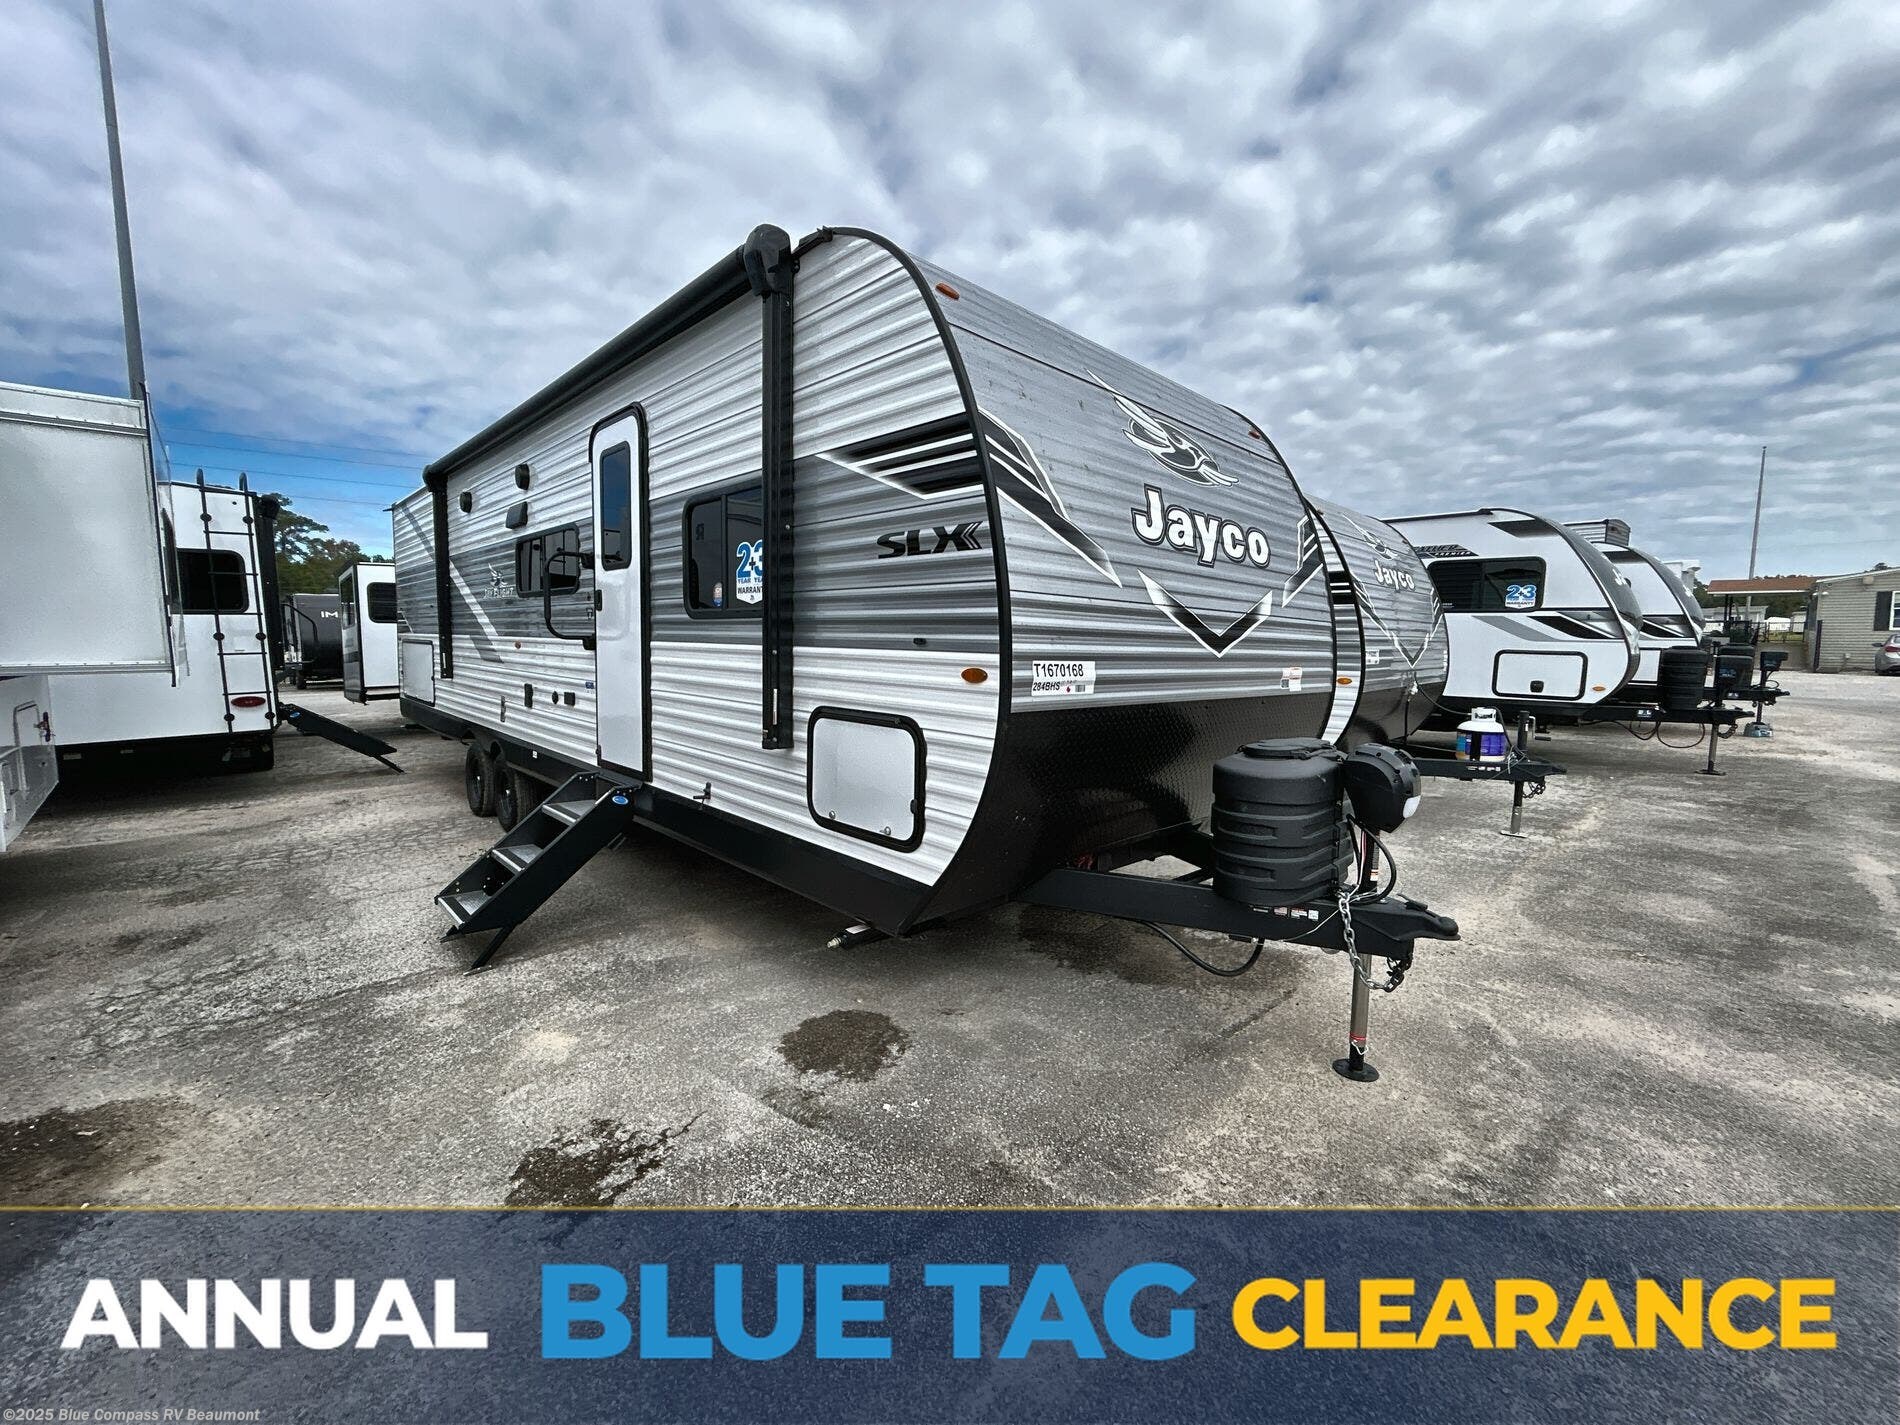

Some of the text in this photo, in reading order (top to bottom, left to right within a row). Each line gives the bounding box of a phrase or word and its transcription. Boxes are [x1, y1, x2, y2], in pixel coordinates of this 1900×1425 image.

[877, 521, 983, 559] SLX
[1131, 483, 1271, 569] Jayco
[1374, 559, 1415, 590] Jayco
[1033, 681, 1061, 691] 284BHS
[1034, 664, 1084, 677] T1670168
